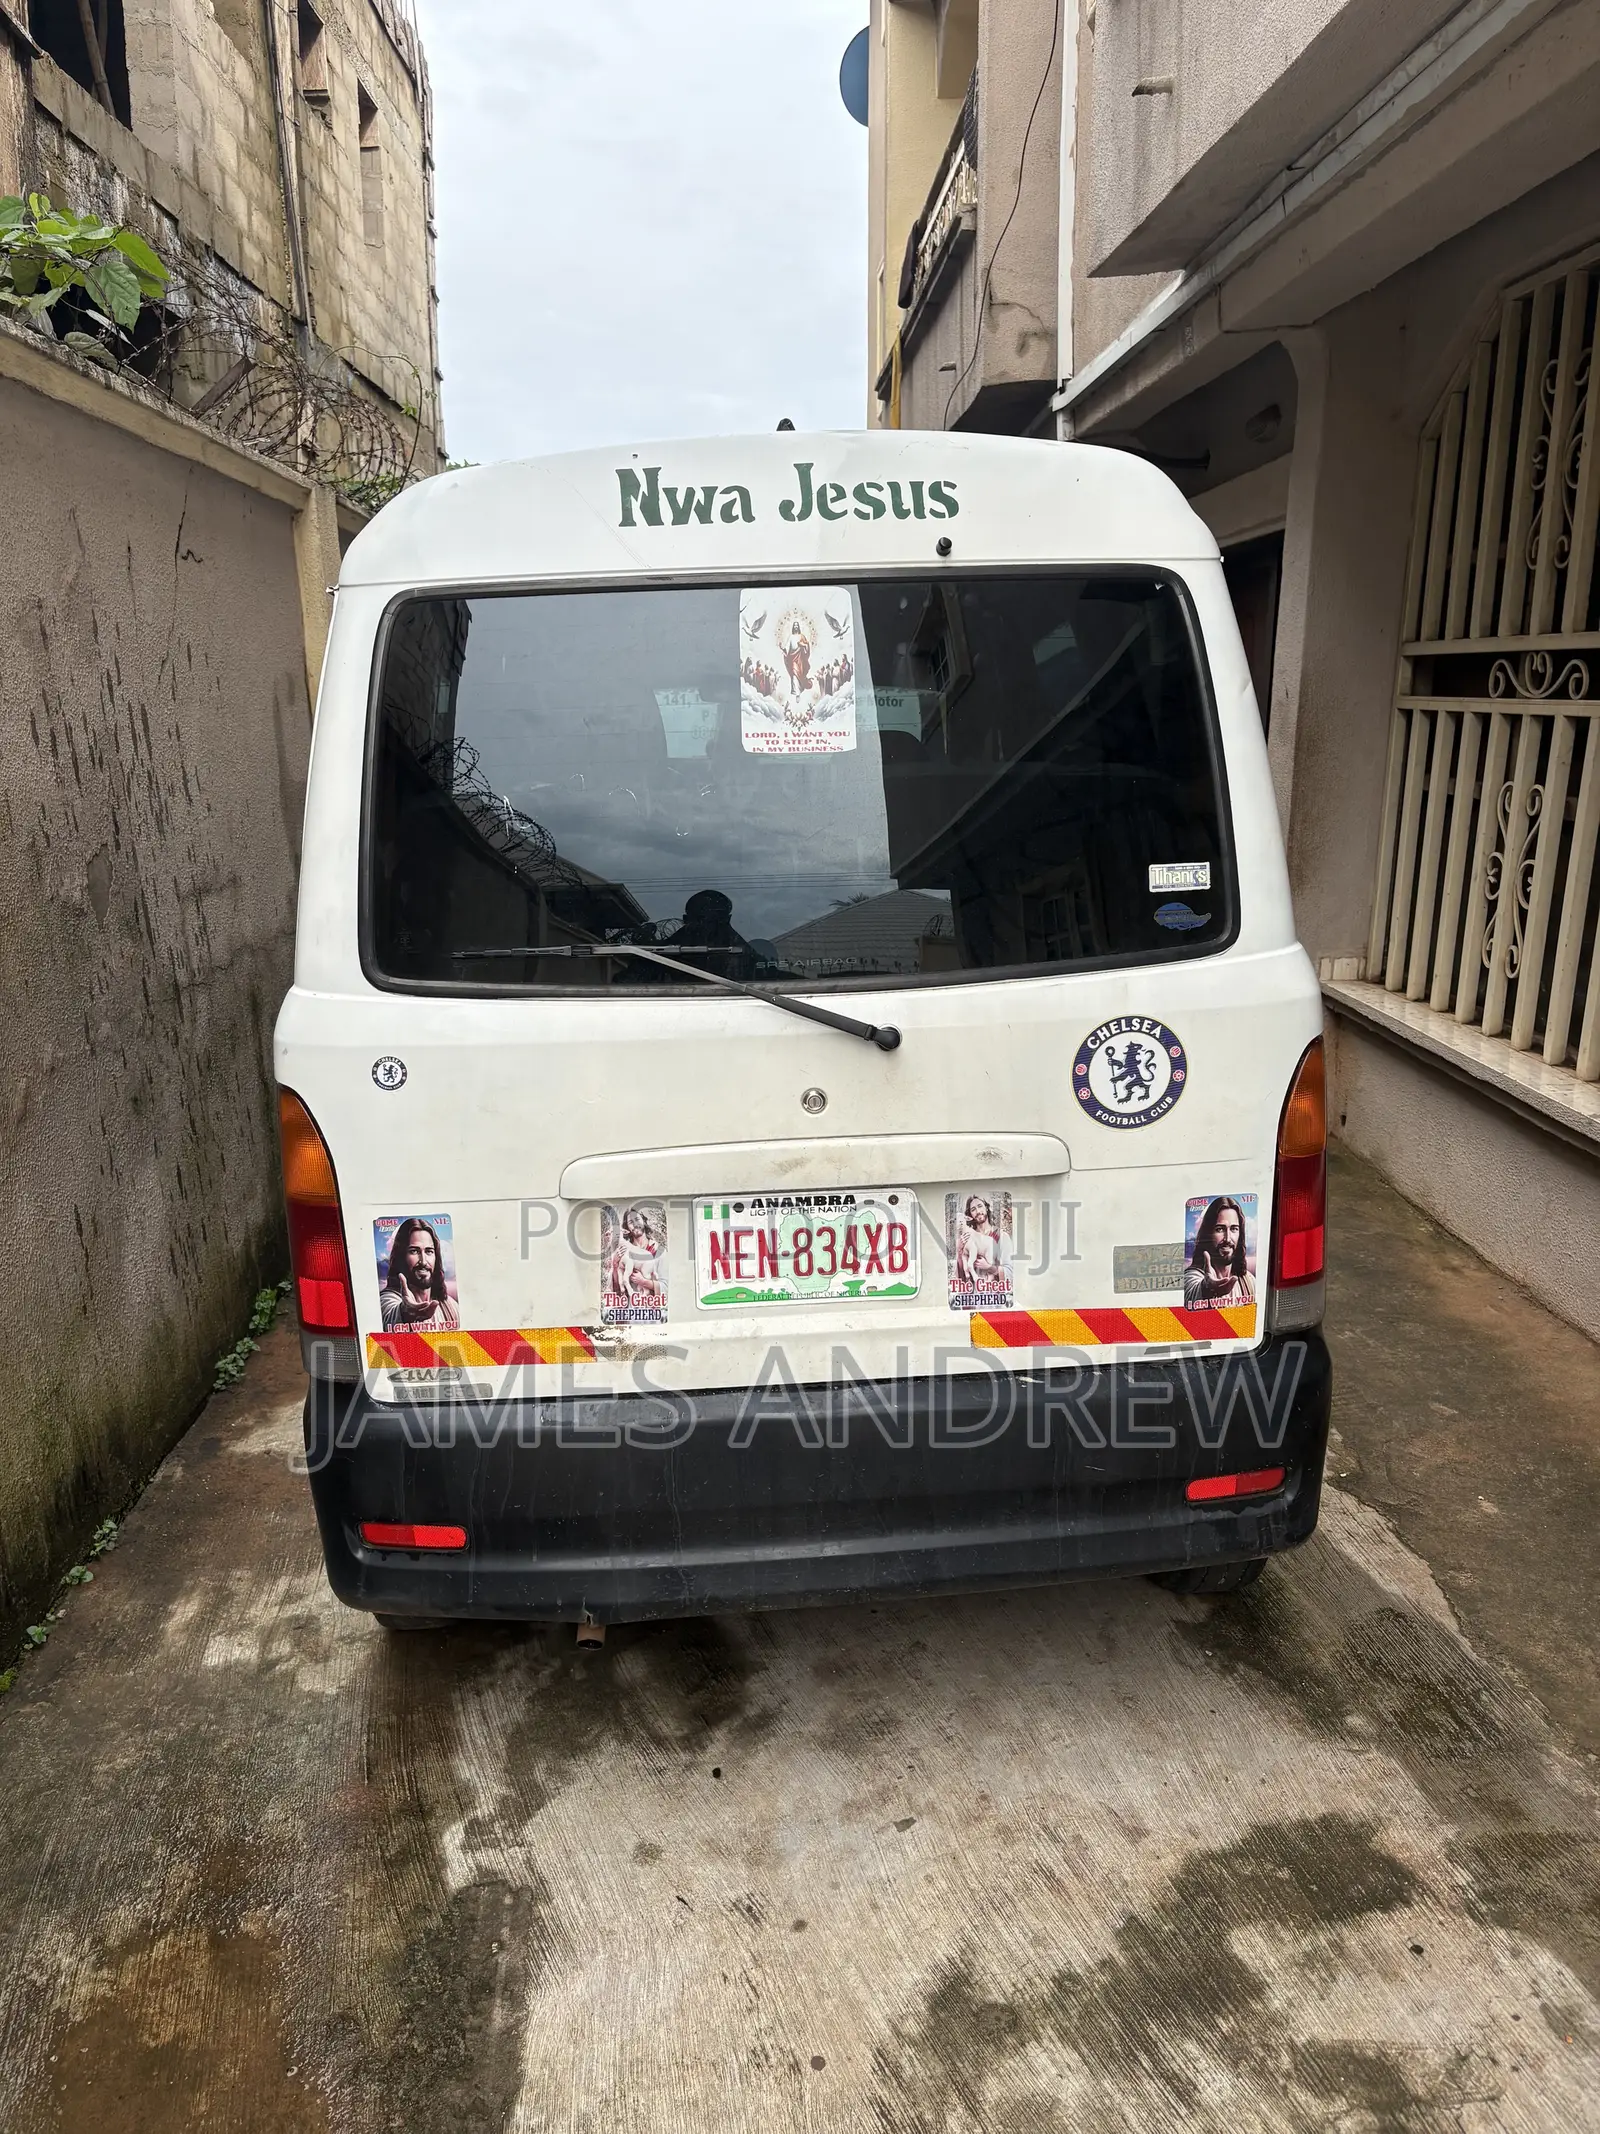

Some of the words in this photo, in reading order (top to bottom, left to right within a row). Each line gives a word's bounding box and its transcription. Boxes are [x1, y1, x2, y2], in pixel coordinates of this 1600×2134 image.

[615, 467, 756, 527] Nwa
[779, 463, 960, 522] Jesus
[793, 957, 857, 967] AIRBAG
[1087, 1018, 1162, 1049] CHELSEA
[1096, 1110, 1147, 1125] FOOTBALL
[1150, 1096, 1173, 1117] CLUB
[751, 1195, 856, 1209] ANAMBRA
[750, 1208, 777, 1216] LIGHT
[781, 1207, 794, 1215] OF
[797, 1206, 815, 1214] THE
[818, 1205, 857, 1214] NATION
[709, 1223, 909, 1281] NEN-834XB
[1138, 1263, 1183, 1276] CARG
[949, 1280, 973, 1293] The
[976, 1279, 1012, 1293] Great
[1129, 1276, 1183, 1290] DAIHAT
[604, 1293, 628, 1307] The
[631, 1293, 667, 1307] Great
[955, 1294, 1007, 1306] SHEPHERD
[1188, 1301, 1192, 1309] I
[1194, 1299, 1208, 1309] AM
[1210, 1298, 1233, 1307] WITH
[1236, 1296, 1254, 1305] YOU
[608, 1309, 662, 1321] SHEPHERD
[388, 1323, 392, 1333] I
[394, 1323, 409, 1333] AM
[411, 1322, 436, 1332] WITH
[439, 1321, 458, 1331] YOU
